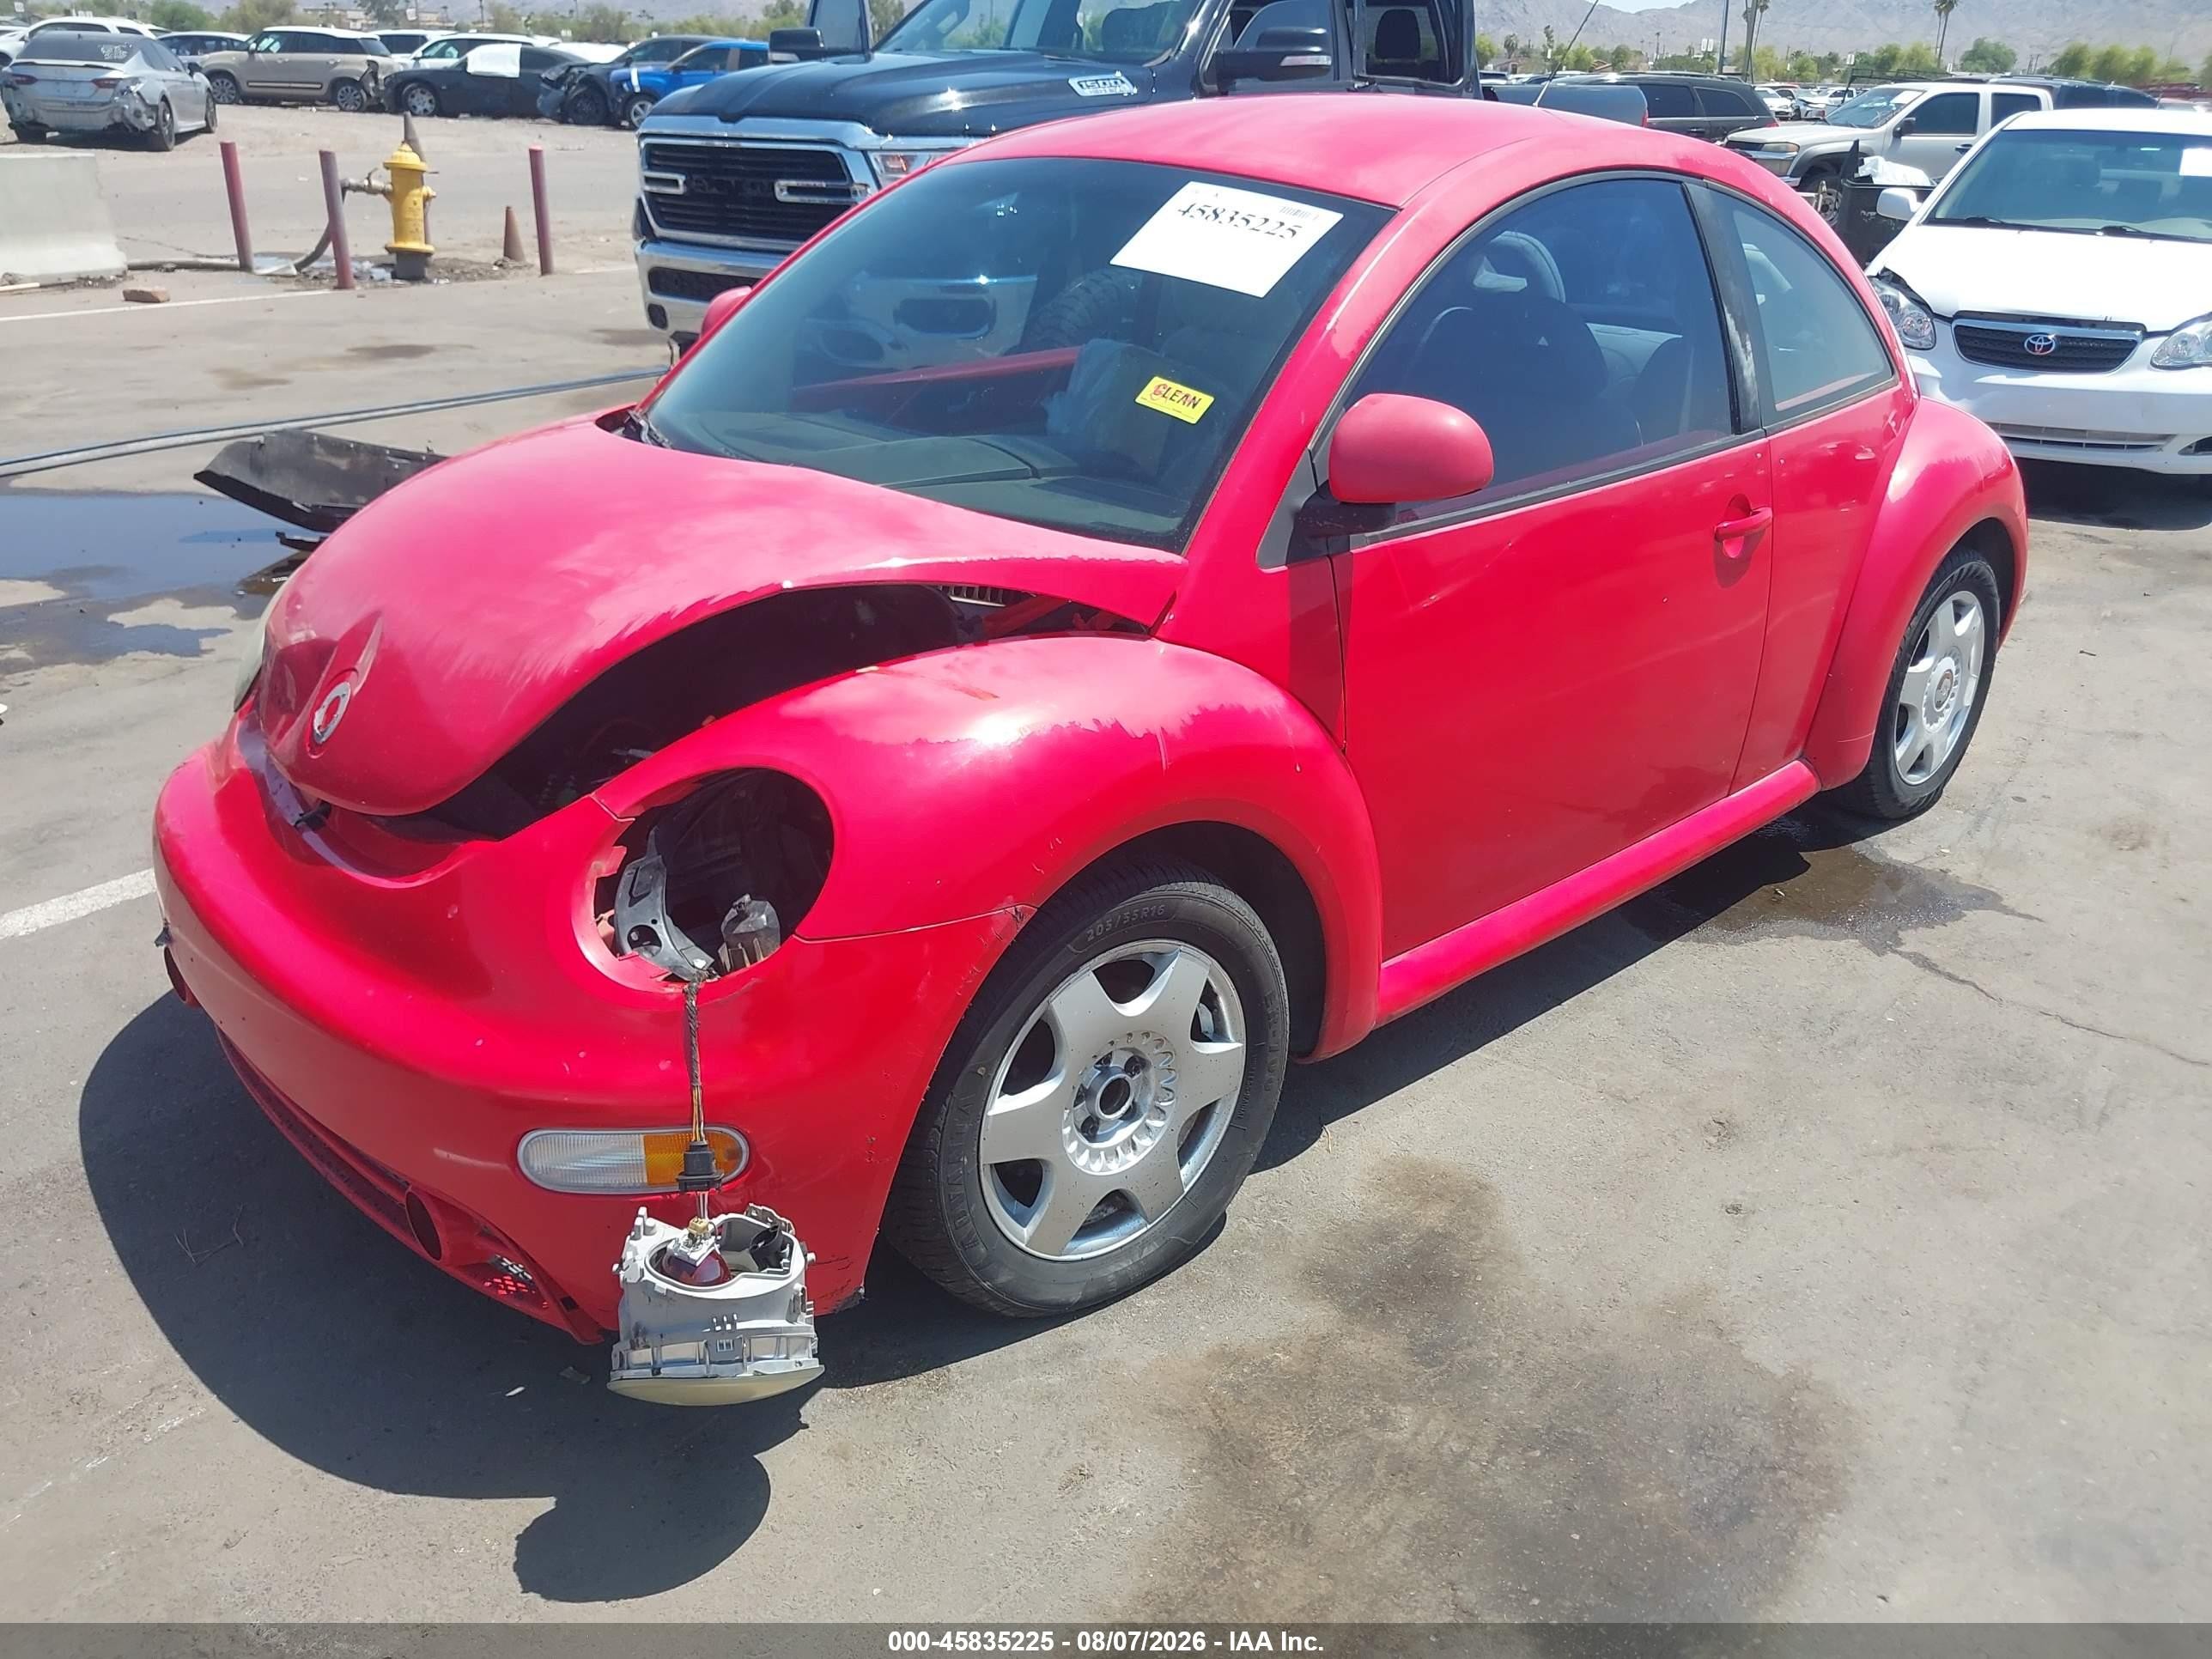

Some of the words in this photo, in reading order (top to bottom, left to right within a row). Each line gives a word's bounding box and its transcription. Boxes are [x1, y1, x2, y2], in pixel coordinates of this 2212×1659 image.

[1079, 78, 1122, 89] 1500
[1177, 203, 1303, 239] 45835225
[1153, 383, 1203, 410] CLEAN
